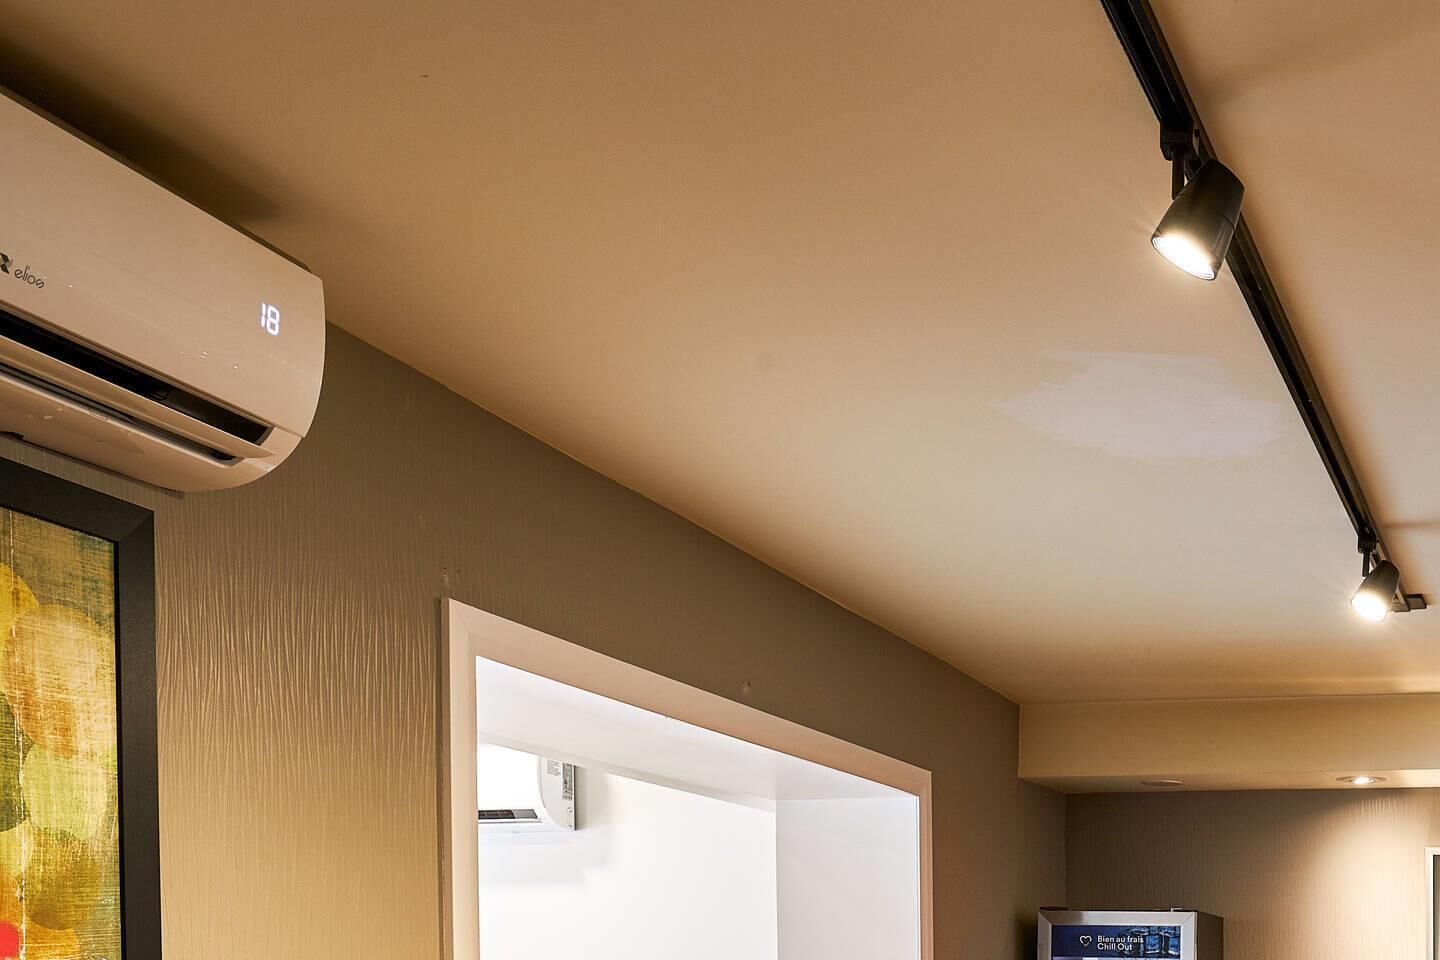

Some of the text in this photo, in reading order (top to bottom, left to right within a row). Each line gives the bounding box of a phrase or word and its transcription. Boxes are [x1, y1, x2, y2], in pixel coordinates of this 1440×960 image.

[14, 265, 45, 289] elios
[261, 302, 280, 335] 18
[1097, 935, 1115, 943] Bien
[1127, 935, 1144, 944] frais
[1097, 942, 1133, 951] Chill Out
